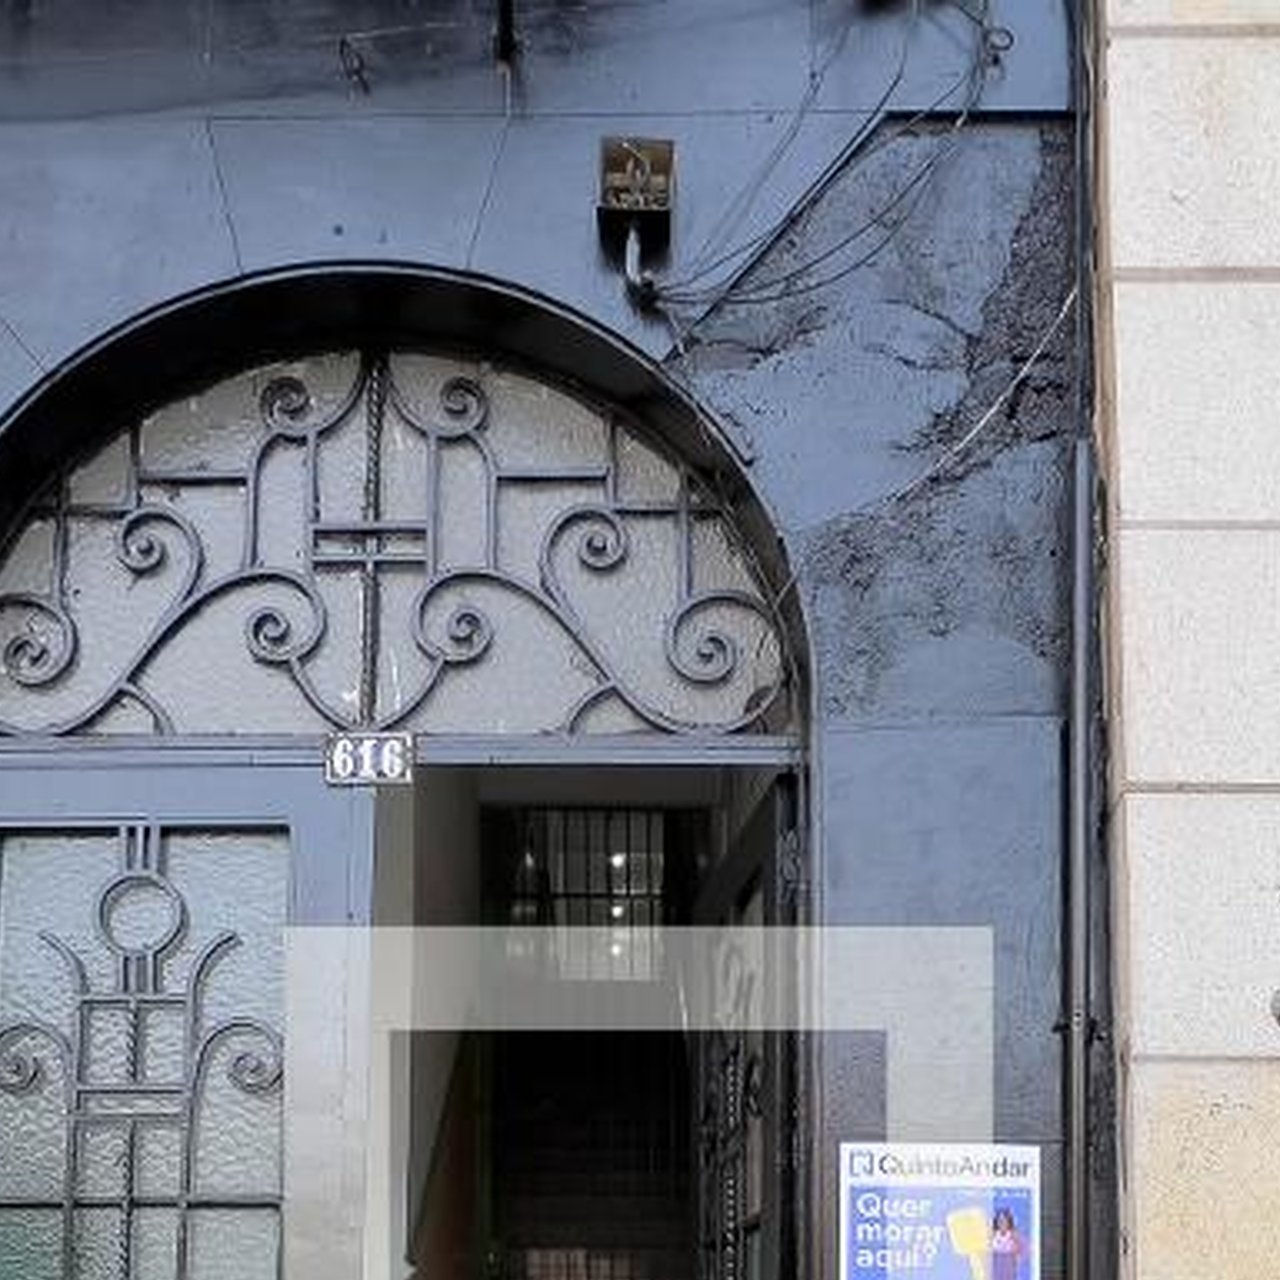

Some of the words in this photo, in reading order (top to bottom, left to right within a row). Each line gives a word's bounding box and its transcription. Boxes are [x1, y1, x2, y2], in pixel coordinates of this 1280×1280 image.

[333, 738, 402, 778] 616
[879, 1153, 1032, 1178] QuintoAndar
[855, 1191, 933, 1219] Quer
[856, 1222, 946, 1242] morar
